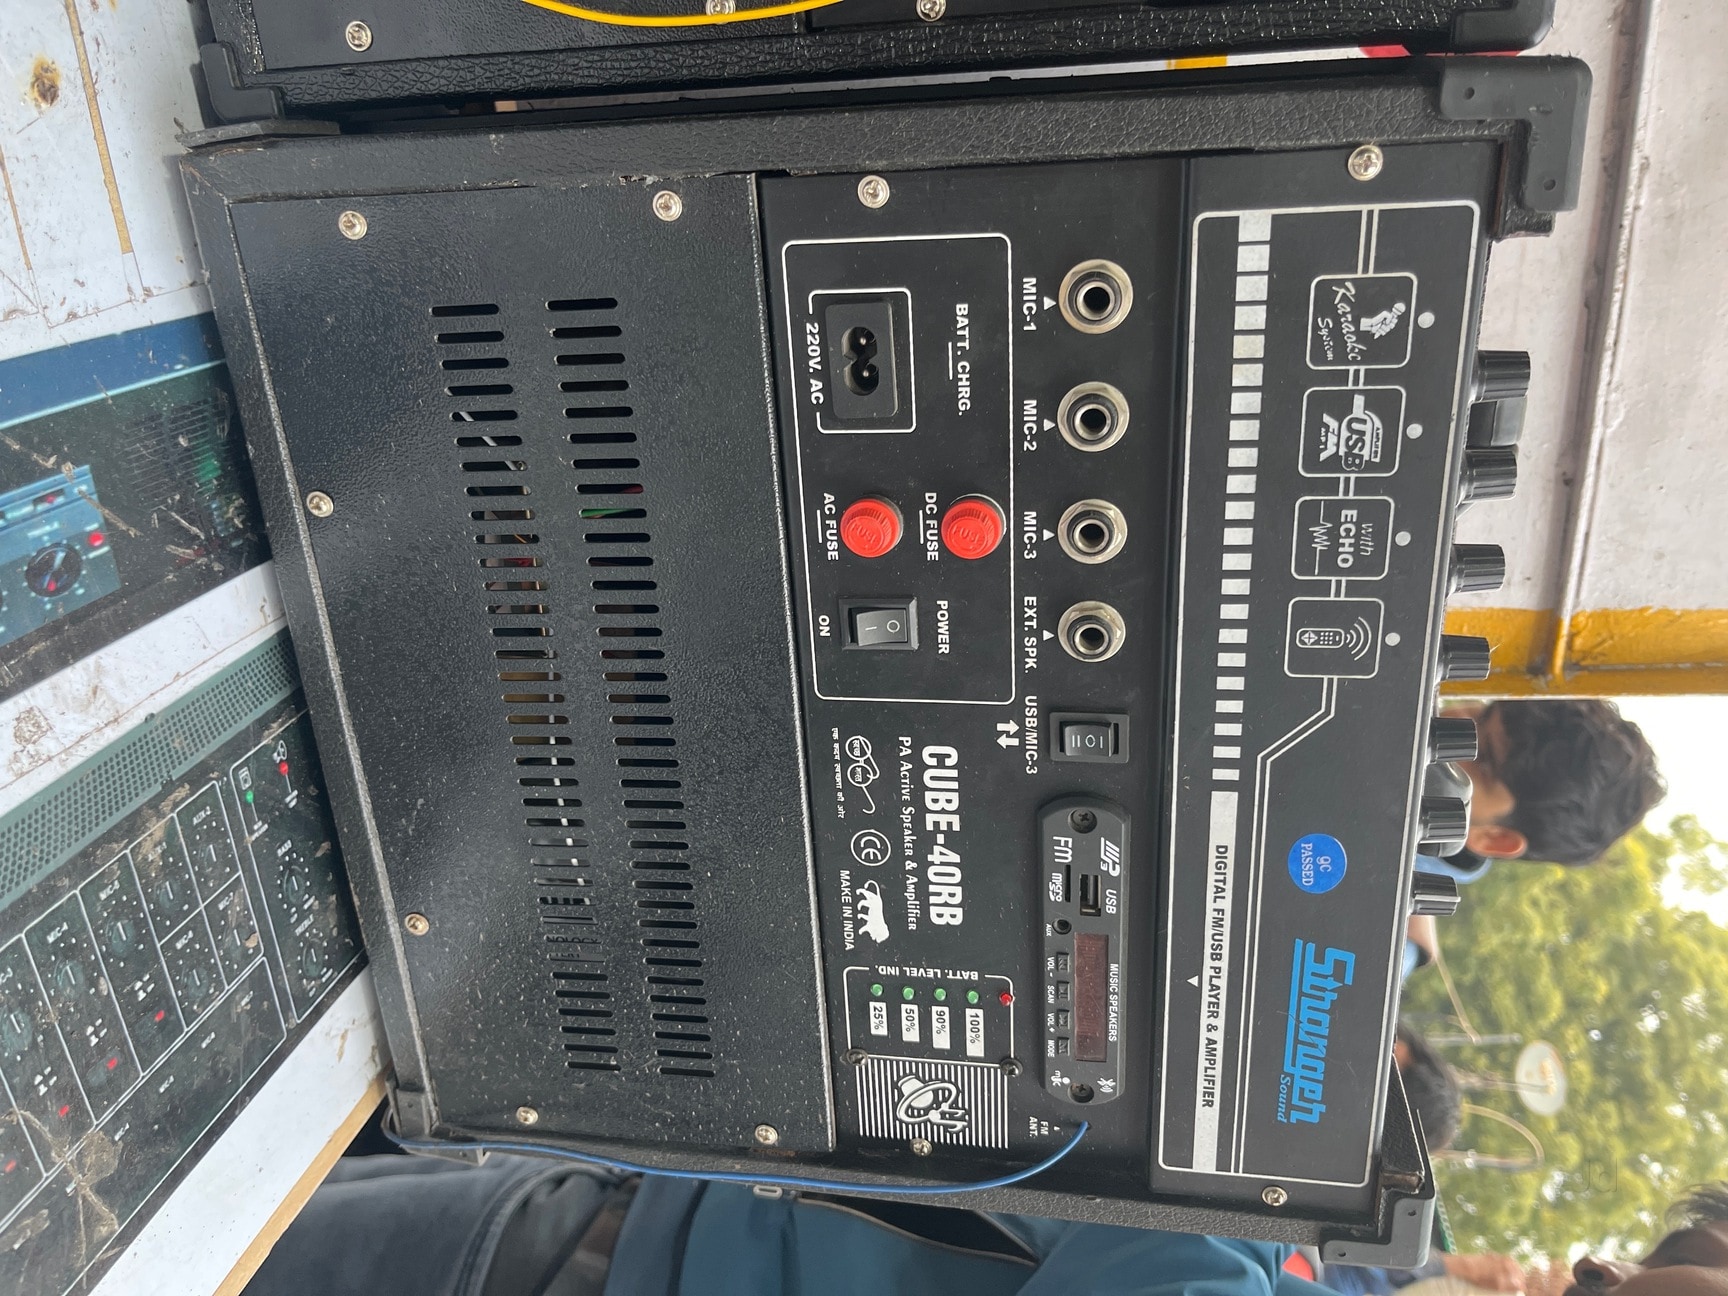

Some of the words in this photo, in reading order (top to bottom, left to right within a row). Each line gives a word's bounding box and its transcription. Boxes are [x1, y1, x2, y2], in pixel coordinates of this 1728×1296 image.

[1022, 278, 1036, 331] MIC-1
[1332, 282, 1367, 361] Karaoke
[806, 322, 822, 372] 220V.
[956, 304, 970, 355] BATT.
[810, 379, 824, 404] AC
[957, 361, 970, 416] CHRG.
[1023, 400, 1037, 451] MIC-2
[1344, 417, 1367, 470] USB
[824, 492, 836, 514] AC
[925, 492, 937, 514] DC
[826, 520, 838, 560] FUSE
[927, 520, 938, 560] FUSE
[1024, 511, 1036, 559] MIC-3
[1337, 510, 1357, 568] ECHO
[1360, 523, 1374, 556] with
[818, 615, 830, 636] ON
[936, 600, 949, 654] POWER
[1024, 596, 1036, 631] EXT.
[1024, 637, 1037, 673] SPK.
[1025, 695, 1038, 774] USB/MIC-3
[898, 737, 911, 756] PA
[905, 860, 918, 870] &
[860, 836, 881, 860] CE
[922, 745, 963, 925] CUBE-40RB
[1053, 836, 1072, 863] FM
[1213, 844, 1228, 904] DIGITAL
[1301, 843, 1314, 886] PASSED
[840, 870, 852, 903] MAKE
[1106, 889, 1116, 914] USB
[843, 906, 853, 917] IN
[843, 920, 855, 950] INDIA
[1210, 908, 1225, 961] FM/USB
[875, 965, 899, 976] IND.
[903, 967, 942, 978] LEVEL
[945, 969, 978, 980] BATT.
[1109, 964, 1118, 992] MUSIC
[1207, 966, 1222, 1019] PLAYER
[874, 1006, 884, 1030] 25%
[905, 1008, 915, 1032] 50%
[936, 1010, 946, 1034] 90%
[970, 1013, 980, 1043] 100%
[1108, 994, 1118, 1041] SPEAKERS
[1206, 1023, 1217, 1032] &
[1284, 938, 1356, 1123] Stranger
[1202, 1037, 1217, 1108] AMPLIFIER
[1278, 1074, 1291, 1123] Sound
[1029, 1117, 1037, 1137] ANT.
[1040, 1121, 1048, 1135] FM
